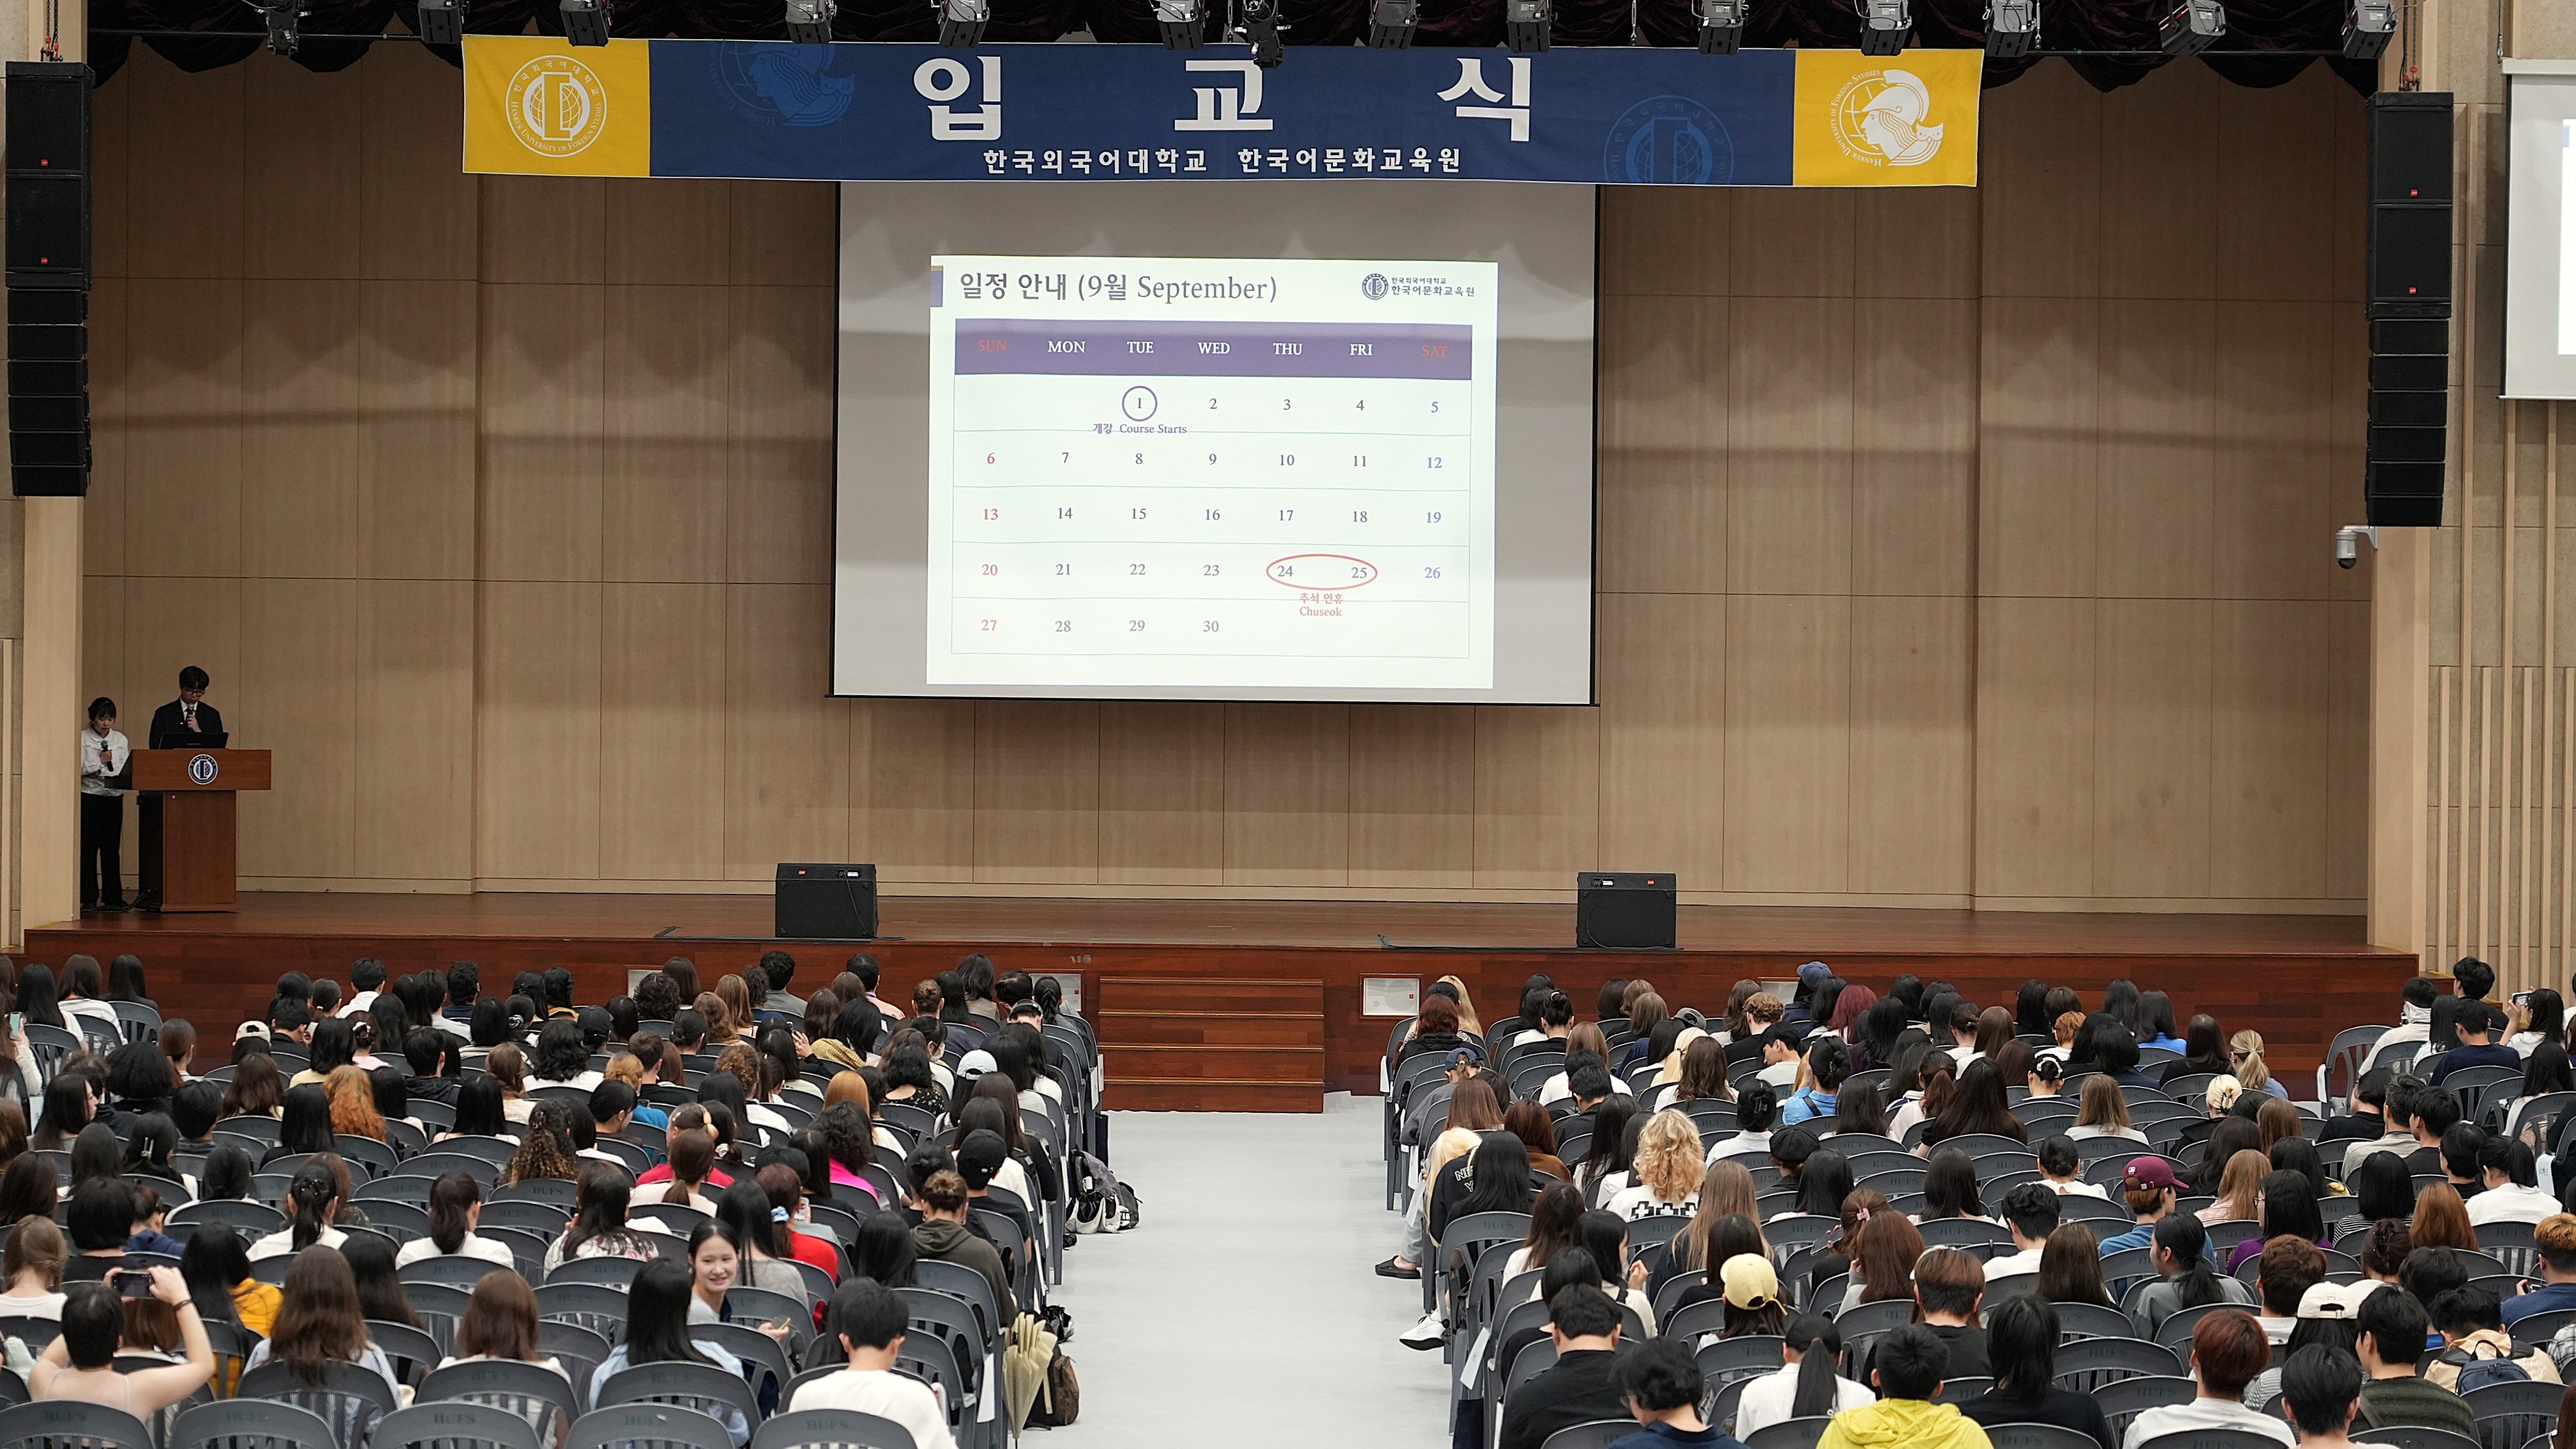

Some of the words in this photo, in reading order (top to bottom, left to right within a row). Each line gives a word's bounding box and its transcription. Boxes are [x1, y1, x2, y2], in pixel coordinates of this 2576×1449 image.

[983, 148, 1207, 174] 한국외국어대학교
[1238, 147, 1459, 173] 한국어문화교육원
[960, 272, 1007, 300] 일정
[1018, 274, 1066, 300] 안내
[1078, 274, 1126, 301] (9월
[1138, 275, 1277, 304] September)
[1391, 285, 1474, 297] 한국어문화교육원
[978, 339, 1006, 352] SUN
[1047, 340, 1086, 353] MON
[1127, 341, 1154, 353] TUE
[1197, 341, 1230, 354] WED
[1272, 342, 1303, 355] THU
[1350, 342, 1373, 356] FRI
[1422, 345, 1447, 358] SAT
[1138, 397, 1142, 409] 1
[1209, 398, 1217, 410] 2
[1283, 399, 1291, 410] 3
[1356, 399, 1365, 411] 4
[1431, 402, 1438, 413] 5
[1092, 423, 1114, 434] 개강
[1119, 424, 1155, 433] Course
[1157, 424, 1187, 434] Starts
[987, 452, 995, 464] 6
[1061, 452, 1069, 464] 7
[1135, 453, 1143, 465] 8
[1209, 453, 1217, 465] 9
[1280, 454, 1295, 466] 10
[1353, 455, 1366, 467] 11
[1427, 457, 1442, 468] 12
[984, 508, 999, 521] 13
[1058, 507, 1073, 519] 14
[1132, 508, 1146, 520] 15
[1206, 509, 1220, 521] 16
[1280, 509, 1294, 521] 17
[1353, 511, 1368, 523] 18
[1427, 512, 1441, 523] 19
[981, 564, 998, 576] 20
[1056, 563, 1070, 576] 21
[1129, 563, 1146, 575] 22
[1203, 564, 1220, 576] 23
[1277, 565, 1294, 577] 24
[1351, 567, 1367, 579] 25
[1424, 567, 1441, 579] 26
[1299, 592, 1319, 604] 추석
[1323, 593, 1344, 604] 연휴
[1299, 606, 1342, 617] Chuseok
[981, 619, 997, 631] 27
[1055, 620, 1071, 632] 28
[1129, 620, 1145, 632] 29
[1203, 620, 1219, 632] 30
[1966, 1141, 1993, 1149] HUFS
[1996, 1161, 2024, 1169] HUFS
[1891, 1178, 1920, 1186] HUFS
[531, 1186, 563, 1195] HUFS
[1483, 1220, 1514, 1229] HUFS
[1792, 1225, 1823, 1234] HUFS
[1940, 1227, 1971, 1236] HUFS
[2090, 1348, 2128, 1358] HUFS
[2138, 1387, 2176, 1397] HUFS
[2504, 1393, 2543, 1402] HUFS
[433, 1414, 476, 1424] HUFS
